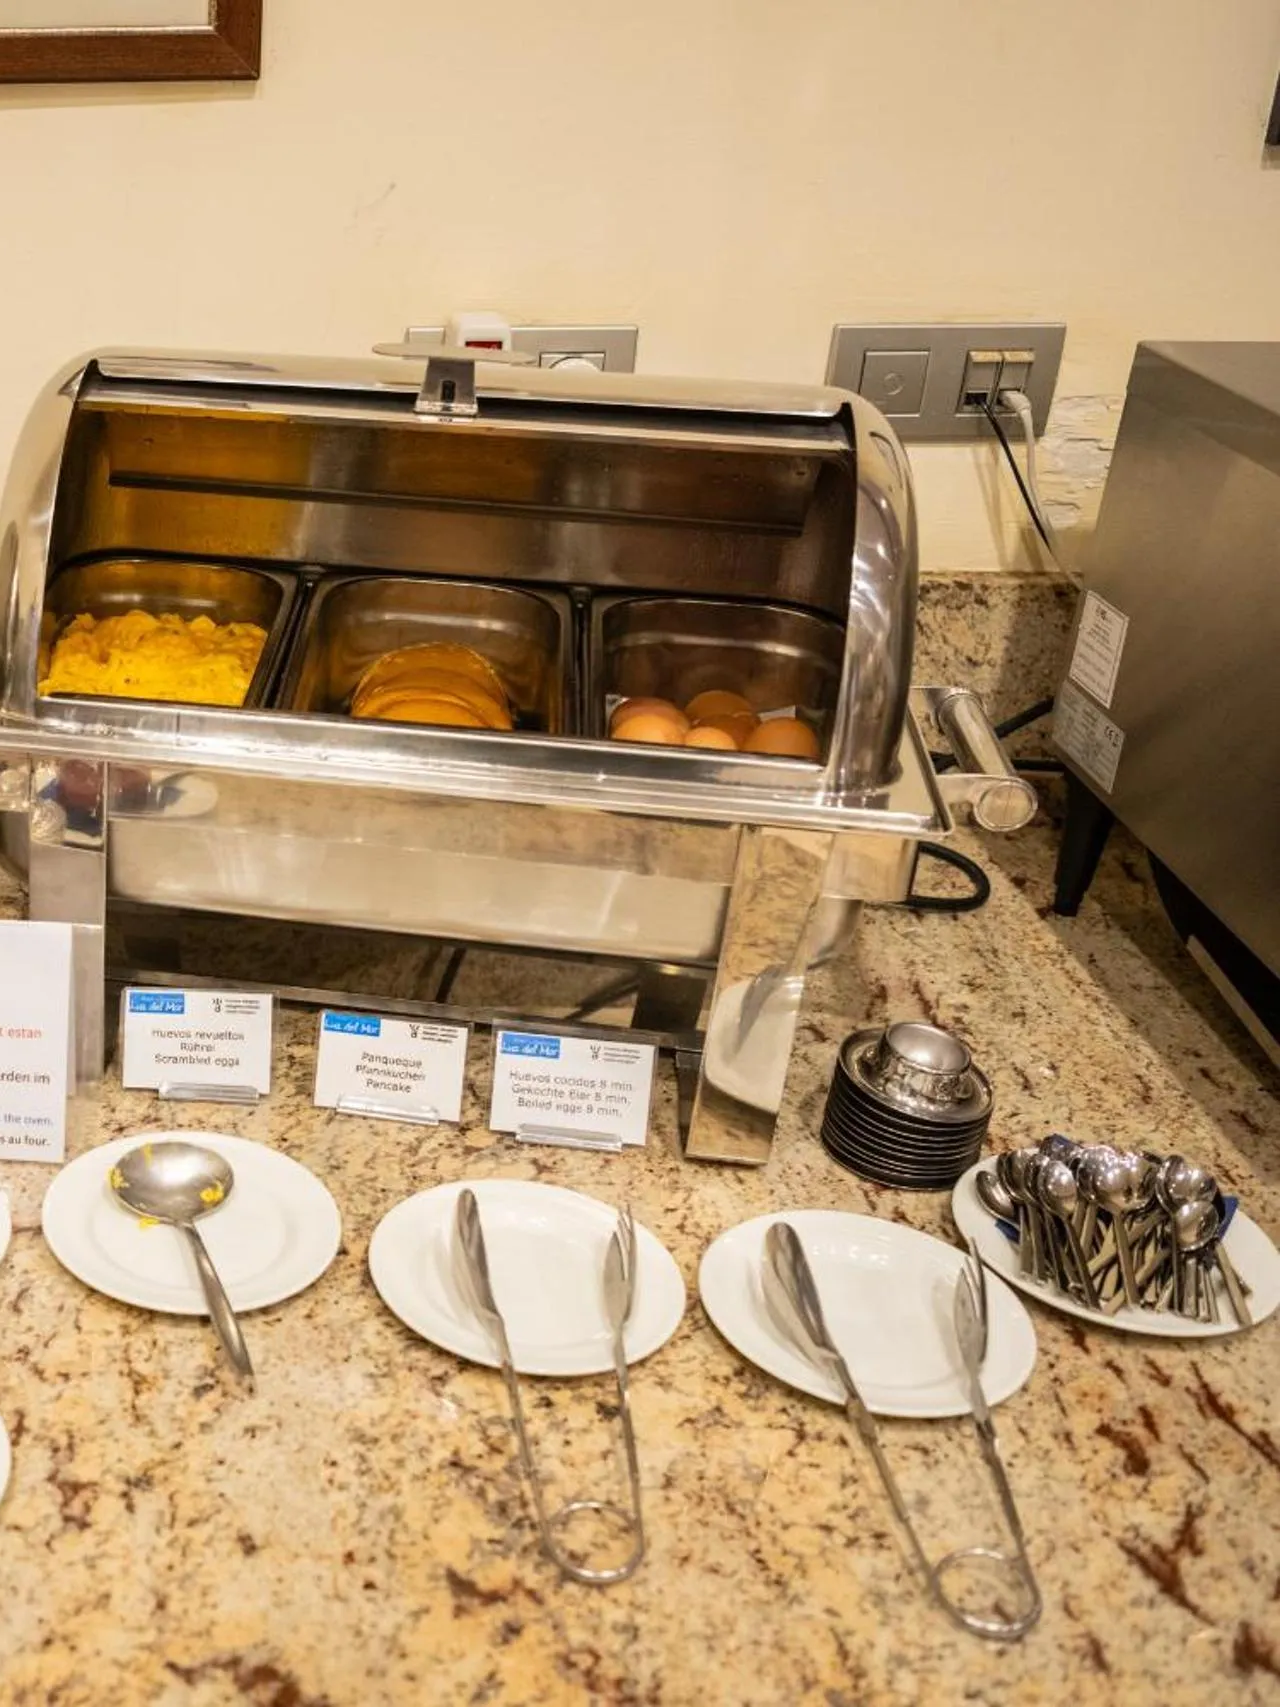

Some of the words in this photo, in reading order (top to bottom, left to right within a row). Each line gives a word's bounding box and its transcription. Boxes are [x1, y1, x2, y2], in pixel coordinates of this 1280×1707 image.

[195, 1029, 245, 1041] revueltos
[154, 1053, 211, 1065] Scrambled
[214, 1057, 240, 1068] eggs
[33, 1073, 51, 1084] im
[509, 1070, 550, 1083] Huevos
[366, 1079, 412, 1094] Pancake
[511, 1084, 565, 1098] Gekochte
[517, 1097, 552, 1110] Boiled
[556, 1103, 582, 1114] eggs
[4, 1112, 21, 1124] the
[23, 1116, 54, 1126] oven.
[8, 1135, 21, 1145] au
[24, 1135, 51, 1147] four.
